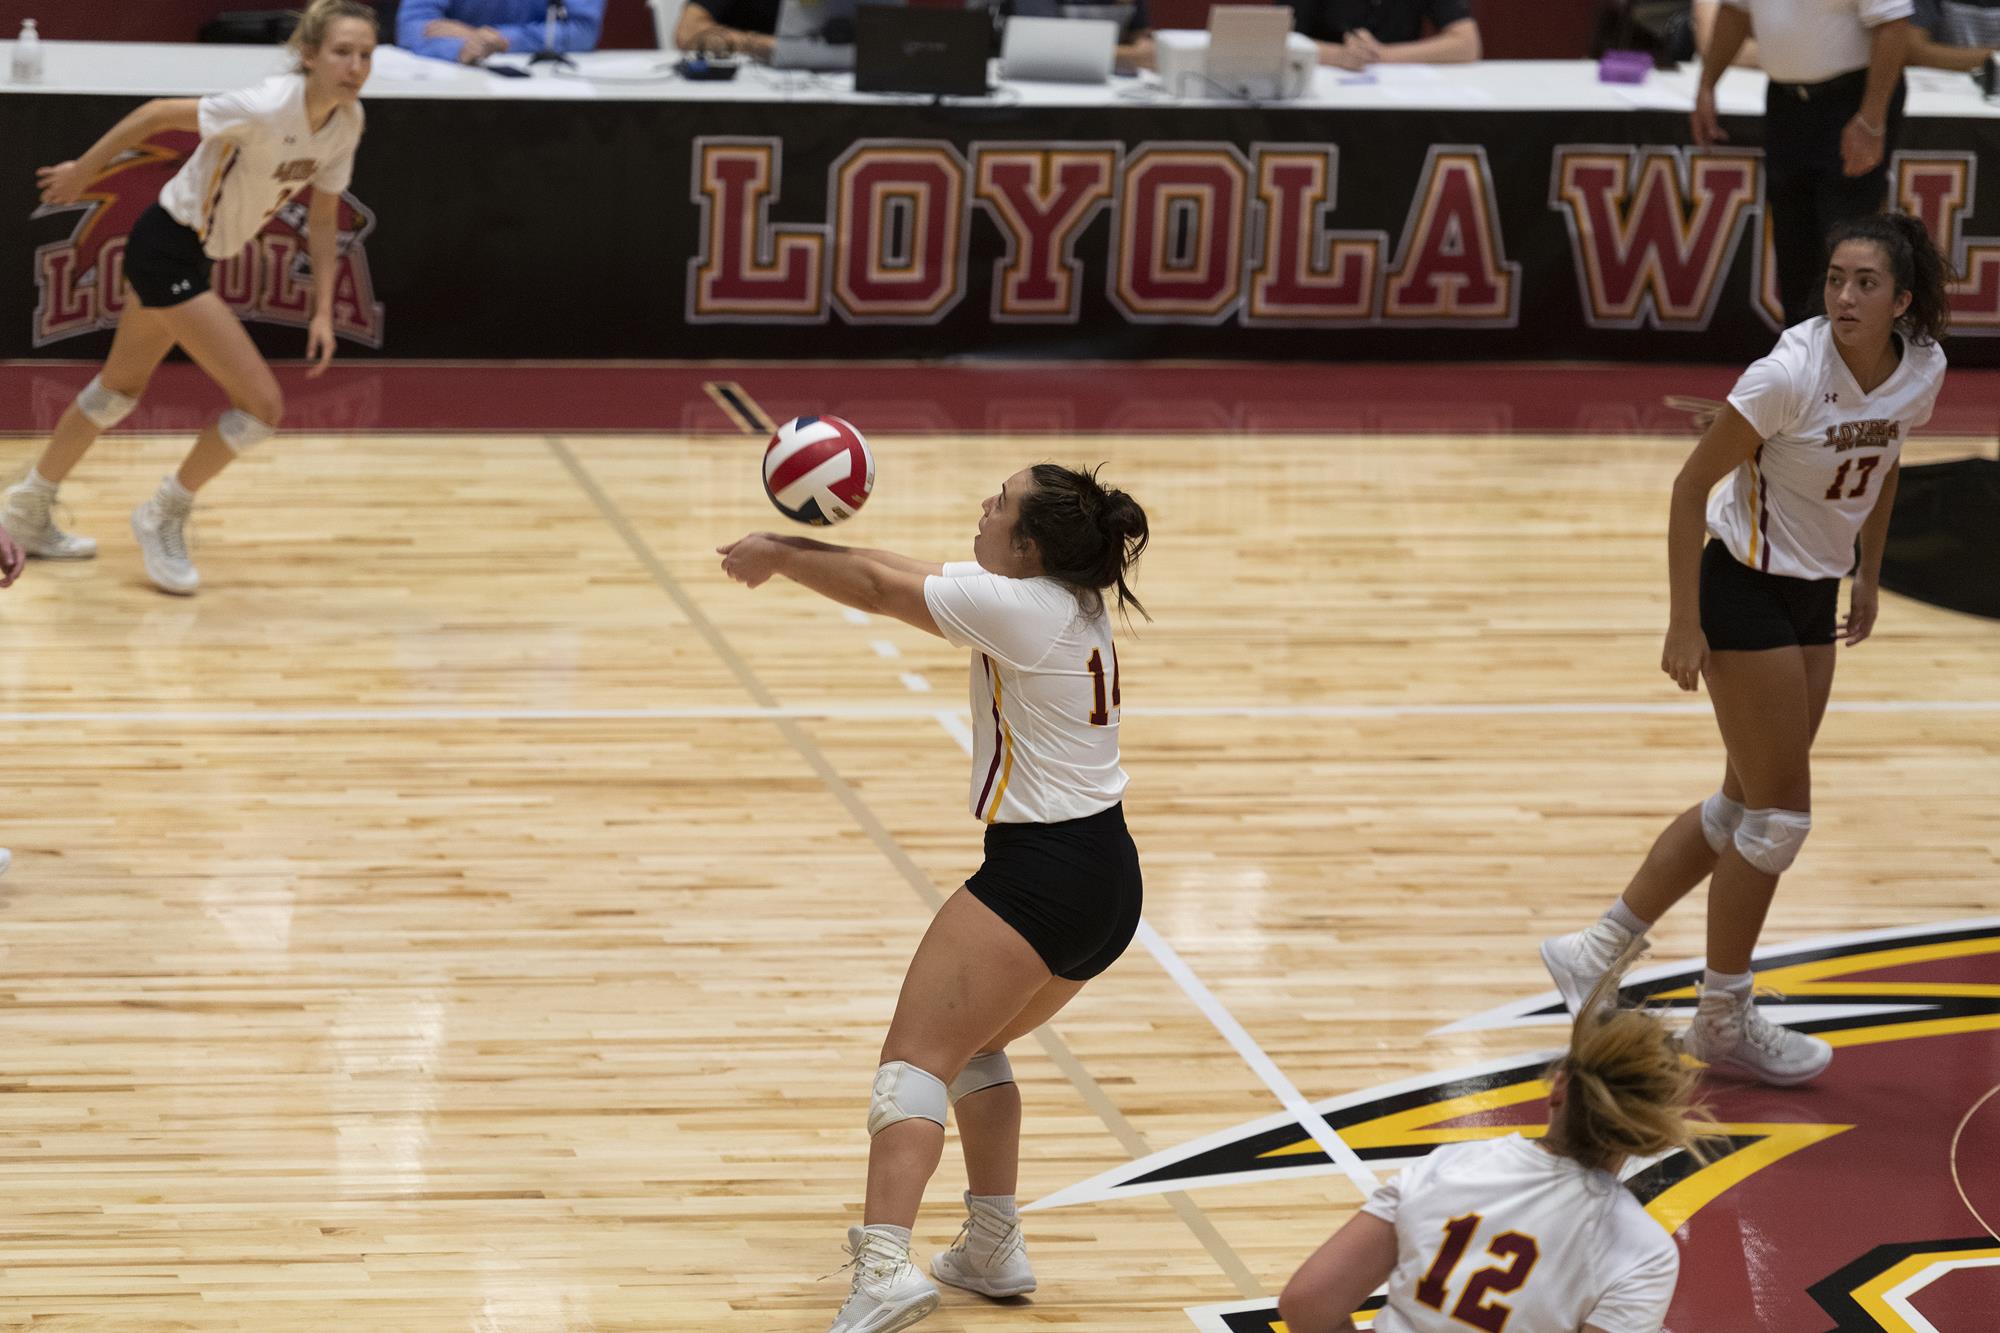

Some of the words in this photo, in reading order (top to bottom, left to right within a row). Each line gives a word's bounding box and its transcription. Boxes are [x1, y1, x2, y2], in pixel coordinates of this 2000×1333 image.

[32, 235, 385, 349] LOLA
[685, 136, 1521, 328] LOYOLA
[1548, 144, 2000, 336] WL
[1824, 455, 1881, 500] 17
[1415, 1211, 1542, 1333] 12
